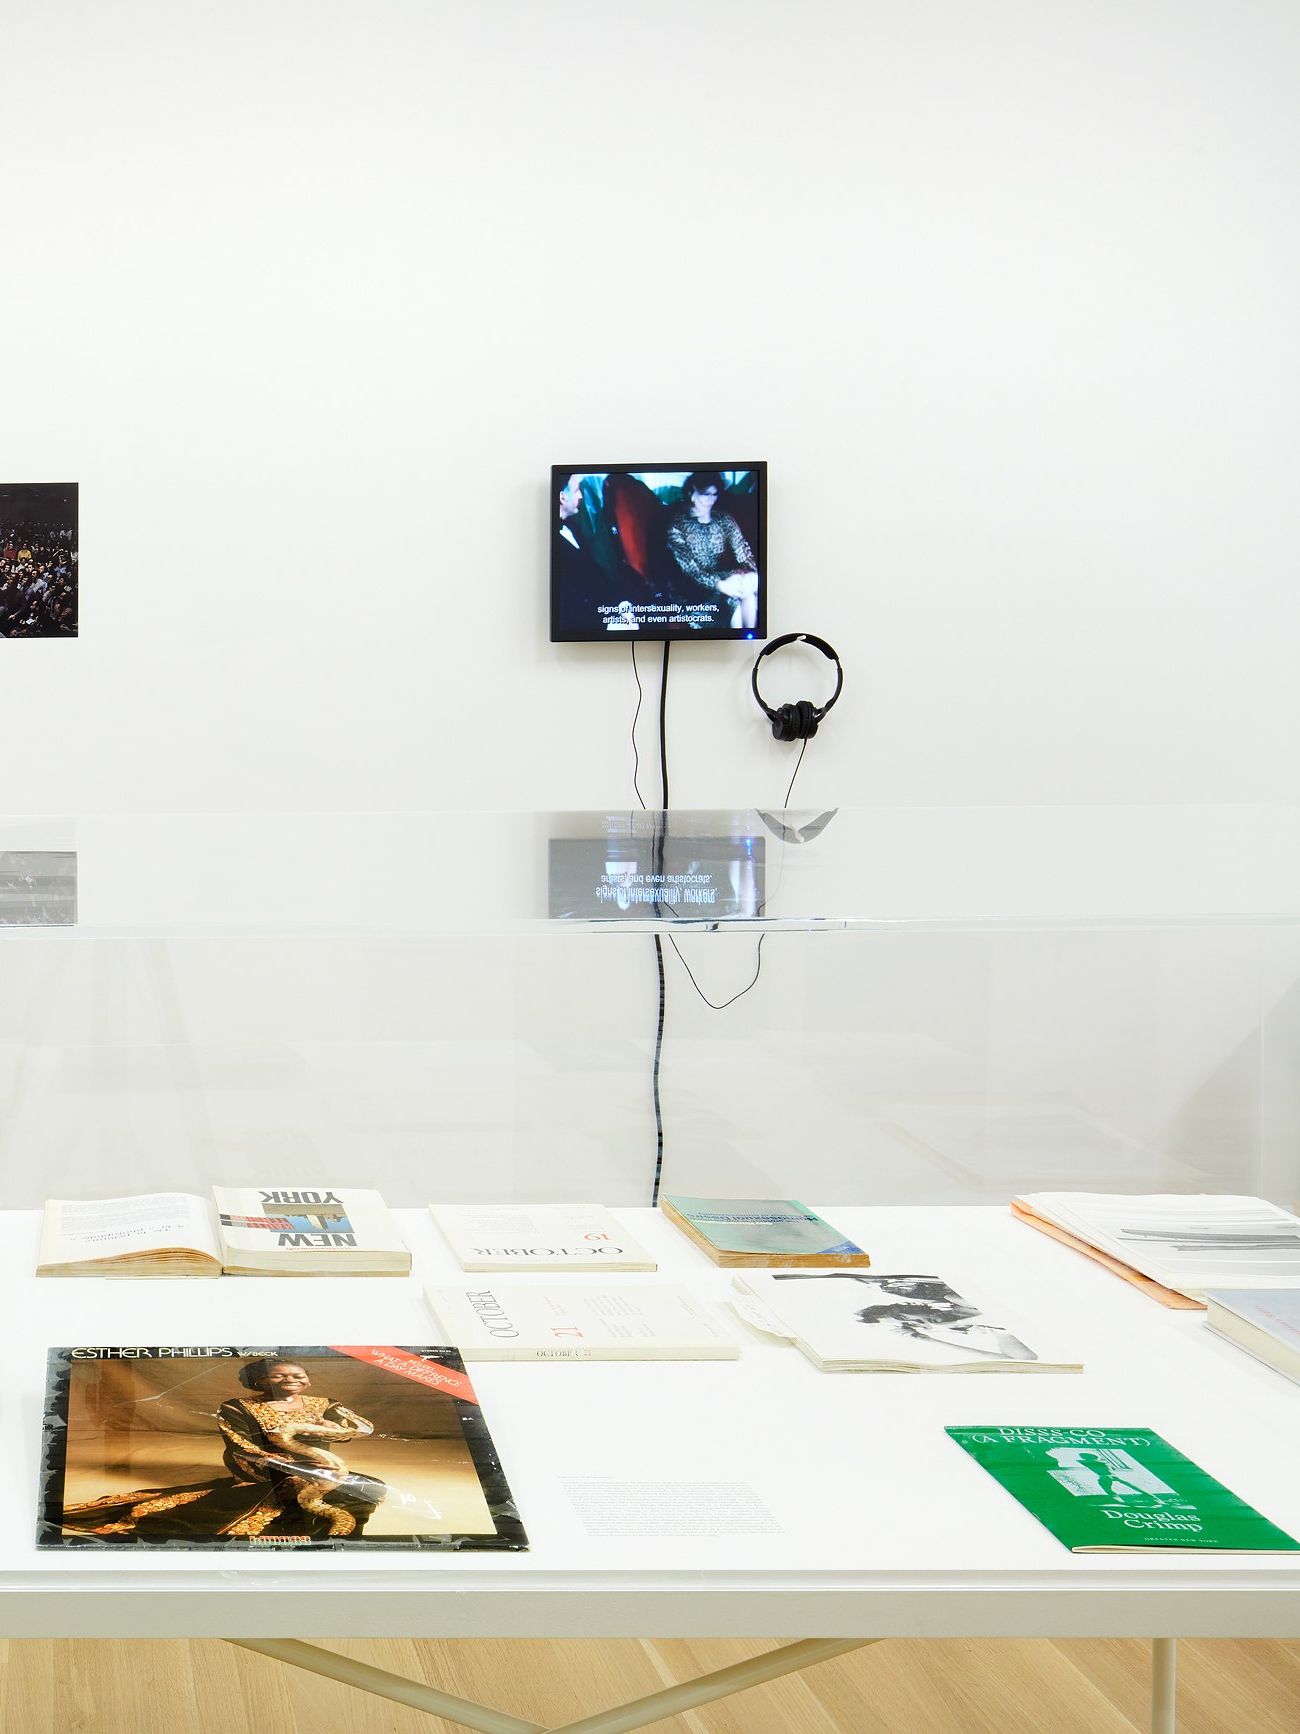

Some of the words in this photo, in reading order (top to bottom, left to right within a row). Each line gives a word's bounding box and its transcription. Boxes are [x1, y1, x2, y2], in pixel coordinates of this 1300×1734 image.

[597, 604, 619, 614] signs
[621, 604, 629, 613] of
[630, 603, 684, 614] intersexuality,
[686, 603, 720, 613] workers,
[603, 615, 630, 625] artists,
[631, 615, 645, 623] and
[669, 614, 715, 623] artistocrats.
[258, 1191, 345, 1204] YORK
[278, 1233, 358, 1247] NEW
[473, 1247, 623, 1256] OCTOBER
[465, 1290, 519, 1338] OCTOBER
[550, 1326, 584, 1338] 21
[71, 1347, 152, 1359] ESTHER
[158, 1347, 233, 1358] PHILLIPS
[371, 1349, 400, 1364] WHAT
[384, 1362, 406, 1371] DAY
[404, 1370, 440, 1386] MAKES
[998, 1428, 1106, 1437] DISSS-CO
[972, 1434, 999, 1444] (A
[1001, 1435, 1151, 1447] FRAGMENT)
[1100, 1510, 1201, 1522] Douglas
[1124, 1520, 1203, 1532] Crimp
